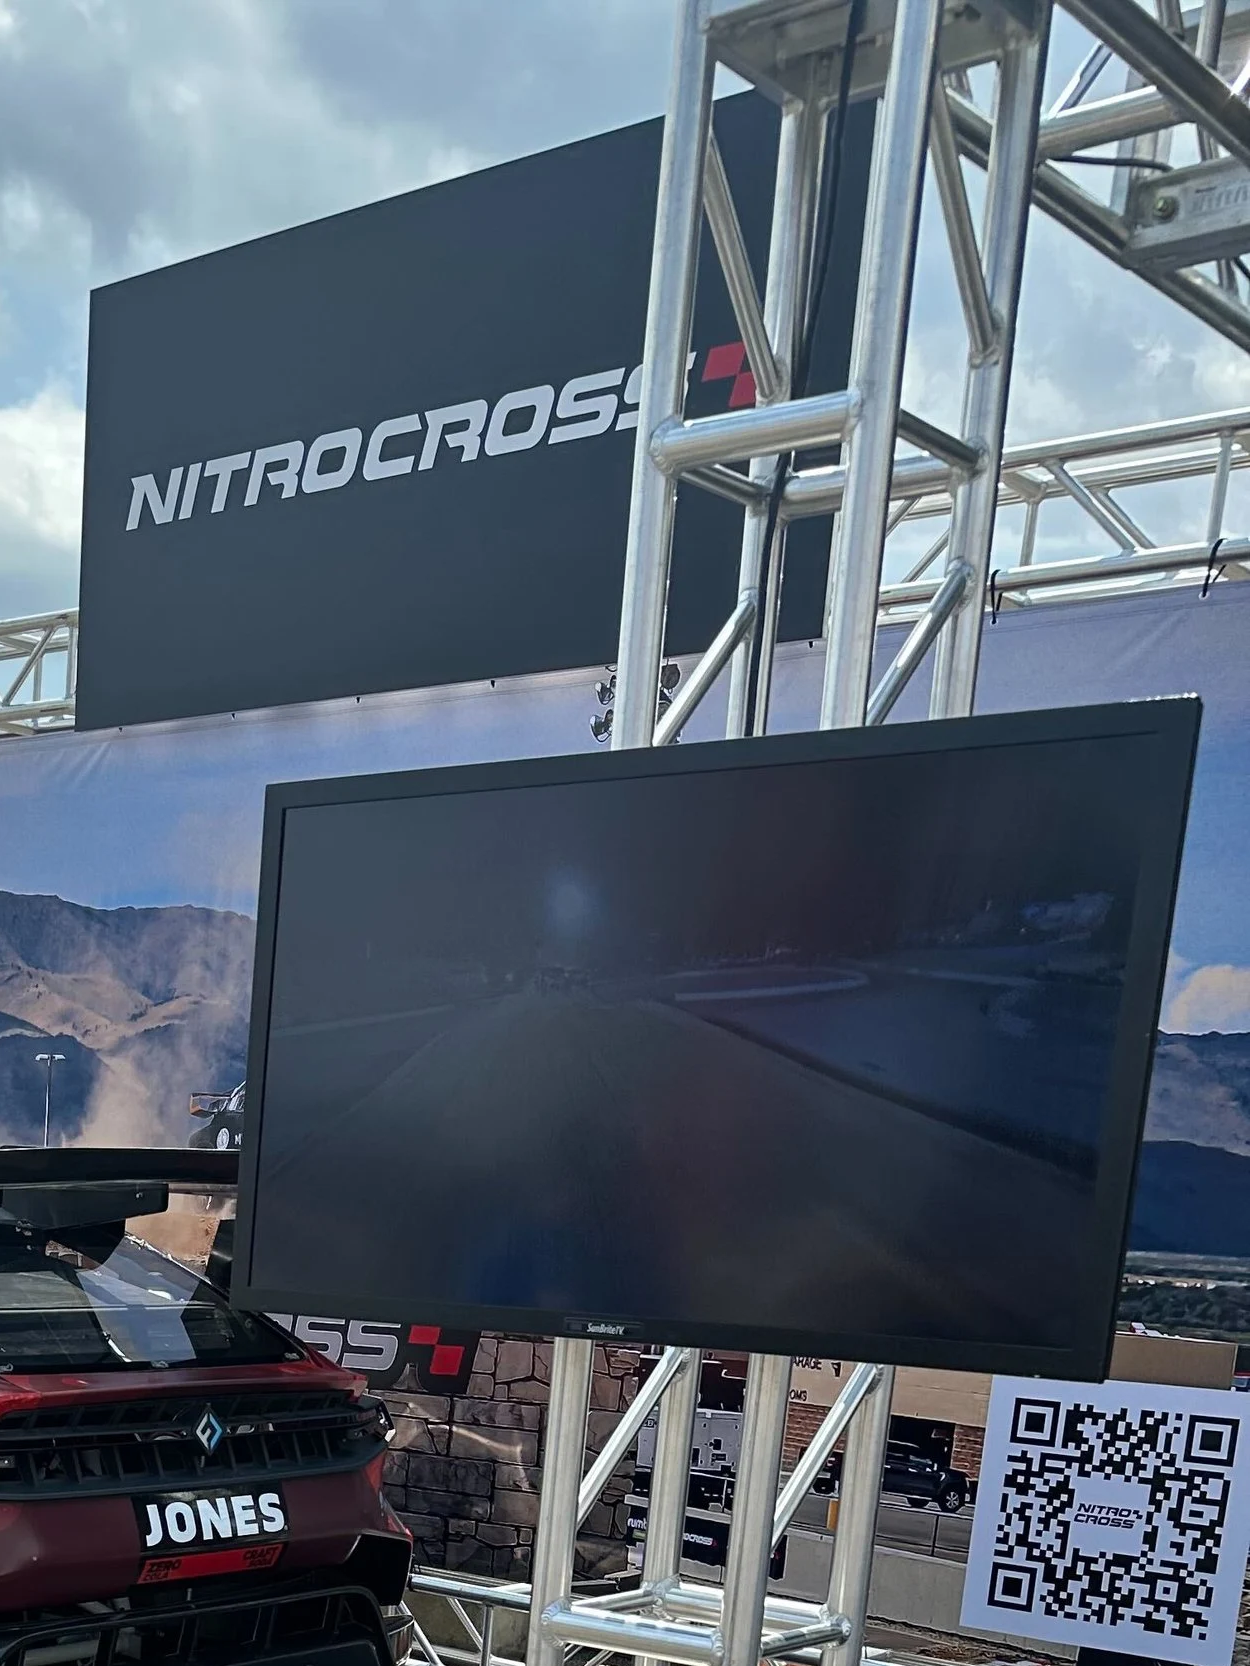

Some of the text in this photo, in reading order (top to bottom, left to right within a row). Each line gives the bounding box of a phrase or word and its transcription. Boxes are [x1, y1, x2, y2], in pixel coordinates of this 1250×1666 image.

[1077, 1502, 1132, 1518] NITRO
[146, 1492, 285, 1547] JONES
[1073, 1513, 1136, 1529] CROSS
[148, 1559, 182, 1572] ZERO
